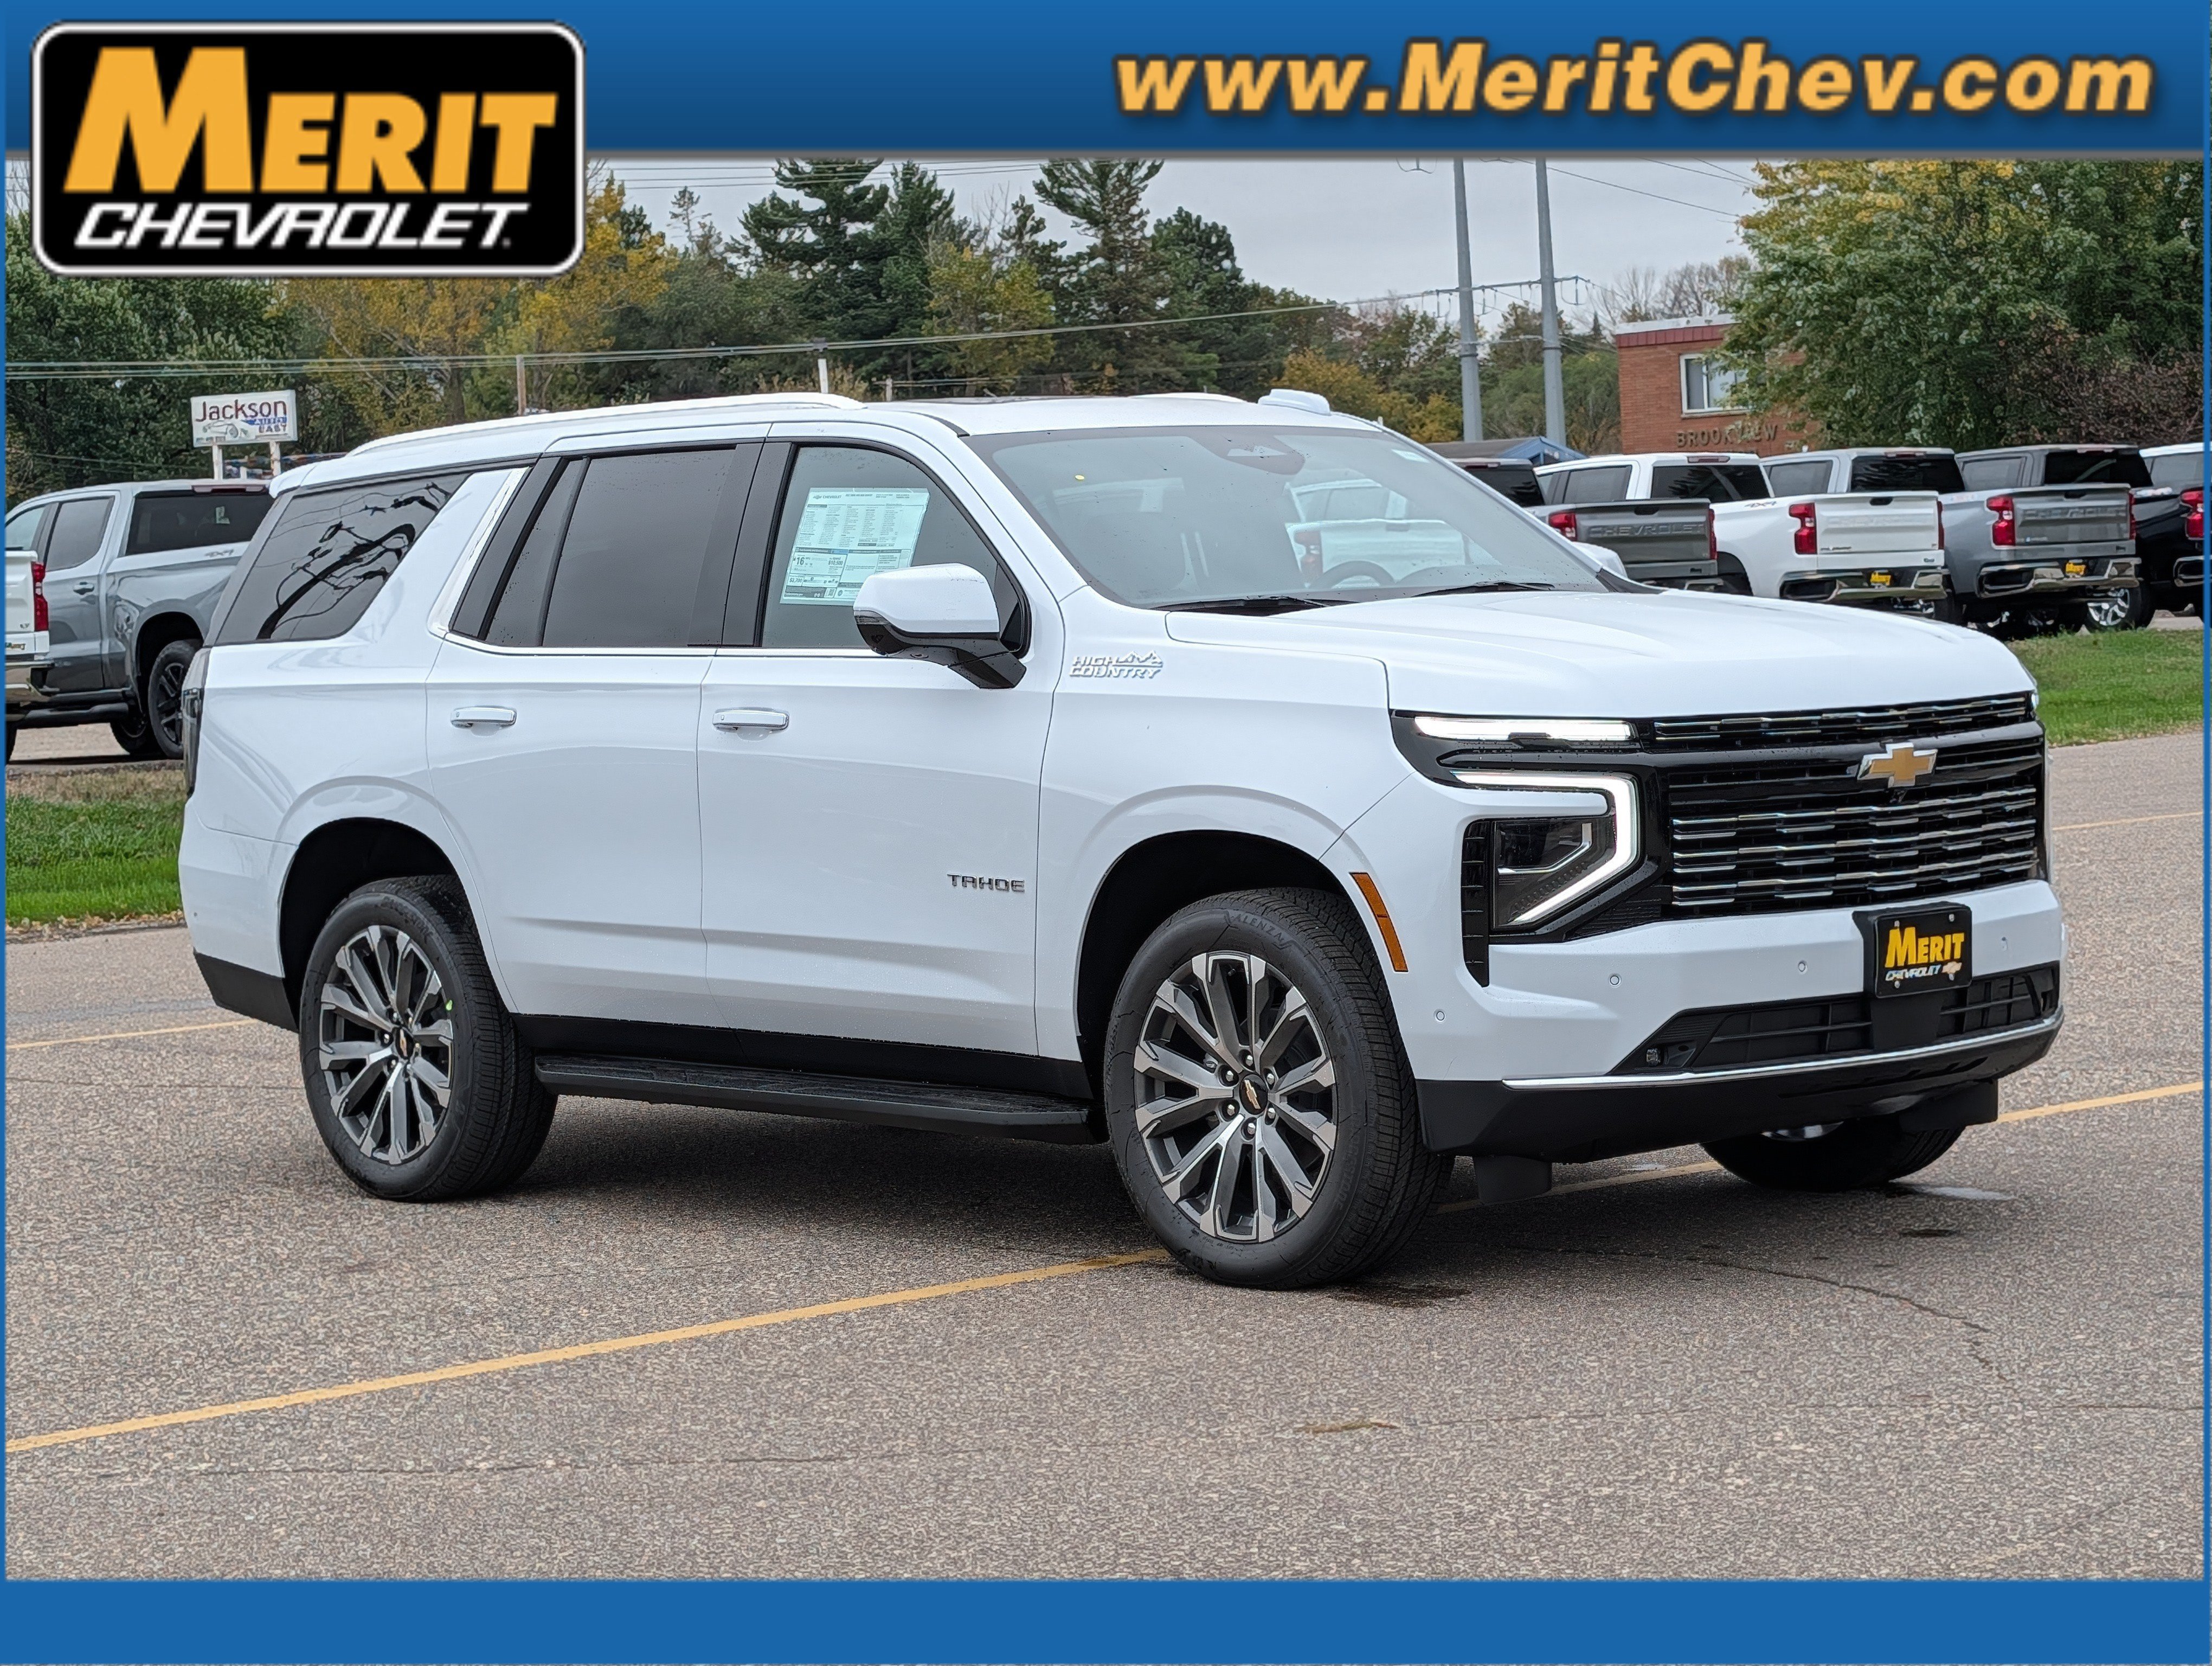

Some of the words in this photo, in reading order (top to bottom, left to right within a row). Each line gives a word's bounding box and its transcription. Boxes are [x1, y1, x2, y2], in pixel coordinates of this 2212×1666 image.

[195, 399, 287, 422] Jackson
[1589, 522, 1706, 537] CHEVROLET
[797, 556, 805, 566] 16
[1070, 665, 1161, 679] COUNTRY
[947, 873, 1025, 892] TAHOE
